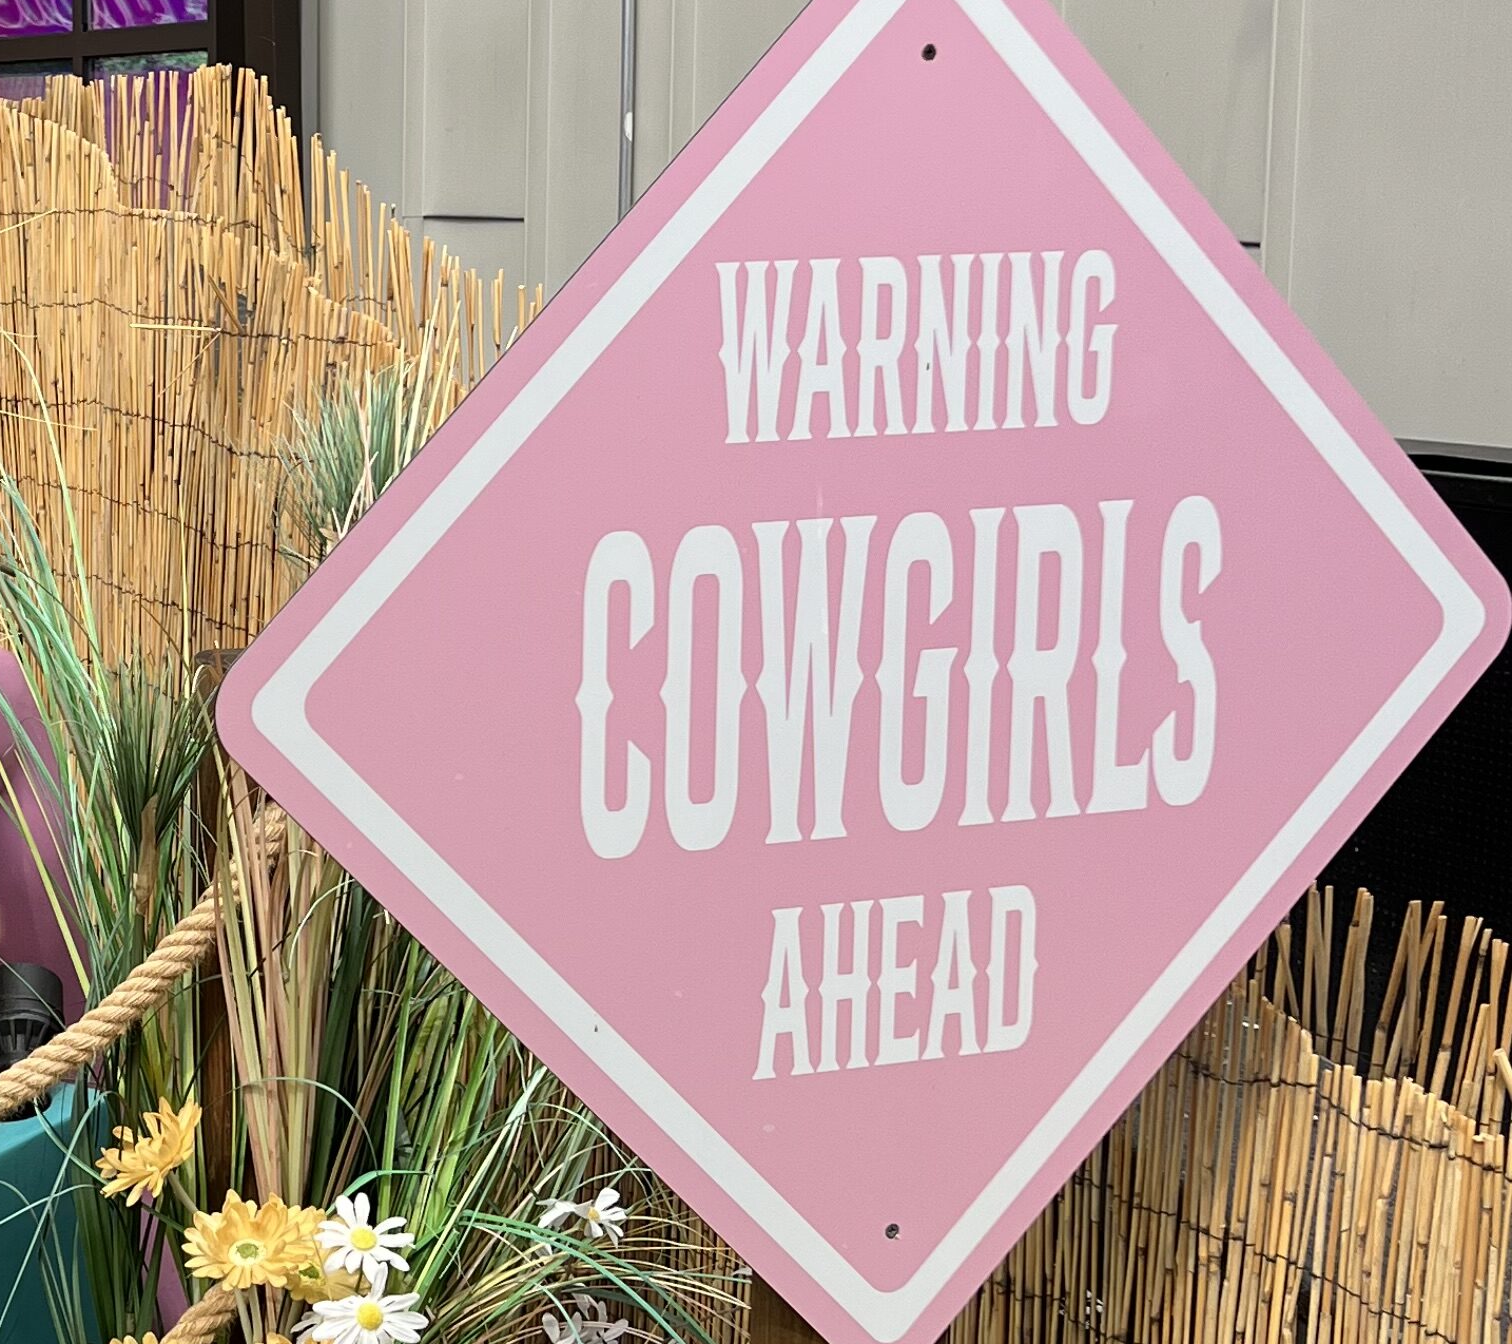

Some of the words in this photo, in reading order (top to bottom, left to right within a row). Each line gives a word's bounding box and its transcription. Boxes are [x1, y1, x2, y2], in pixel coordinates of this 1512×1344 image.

[714, 249, 1119, 444] WARNING
[575, 495, 1223, 860] COWGIRLS
[752, 884, 1039, 1082] AHEAD
